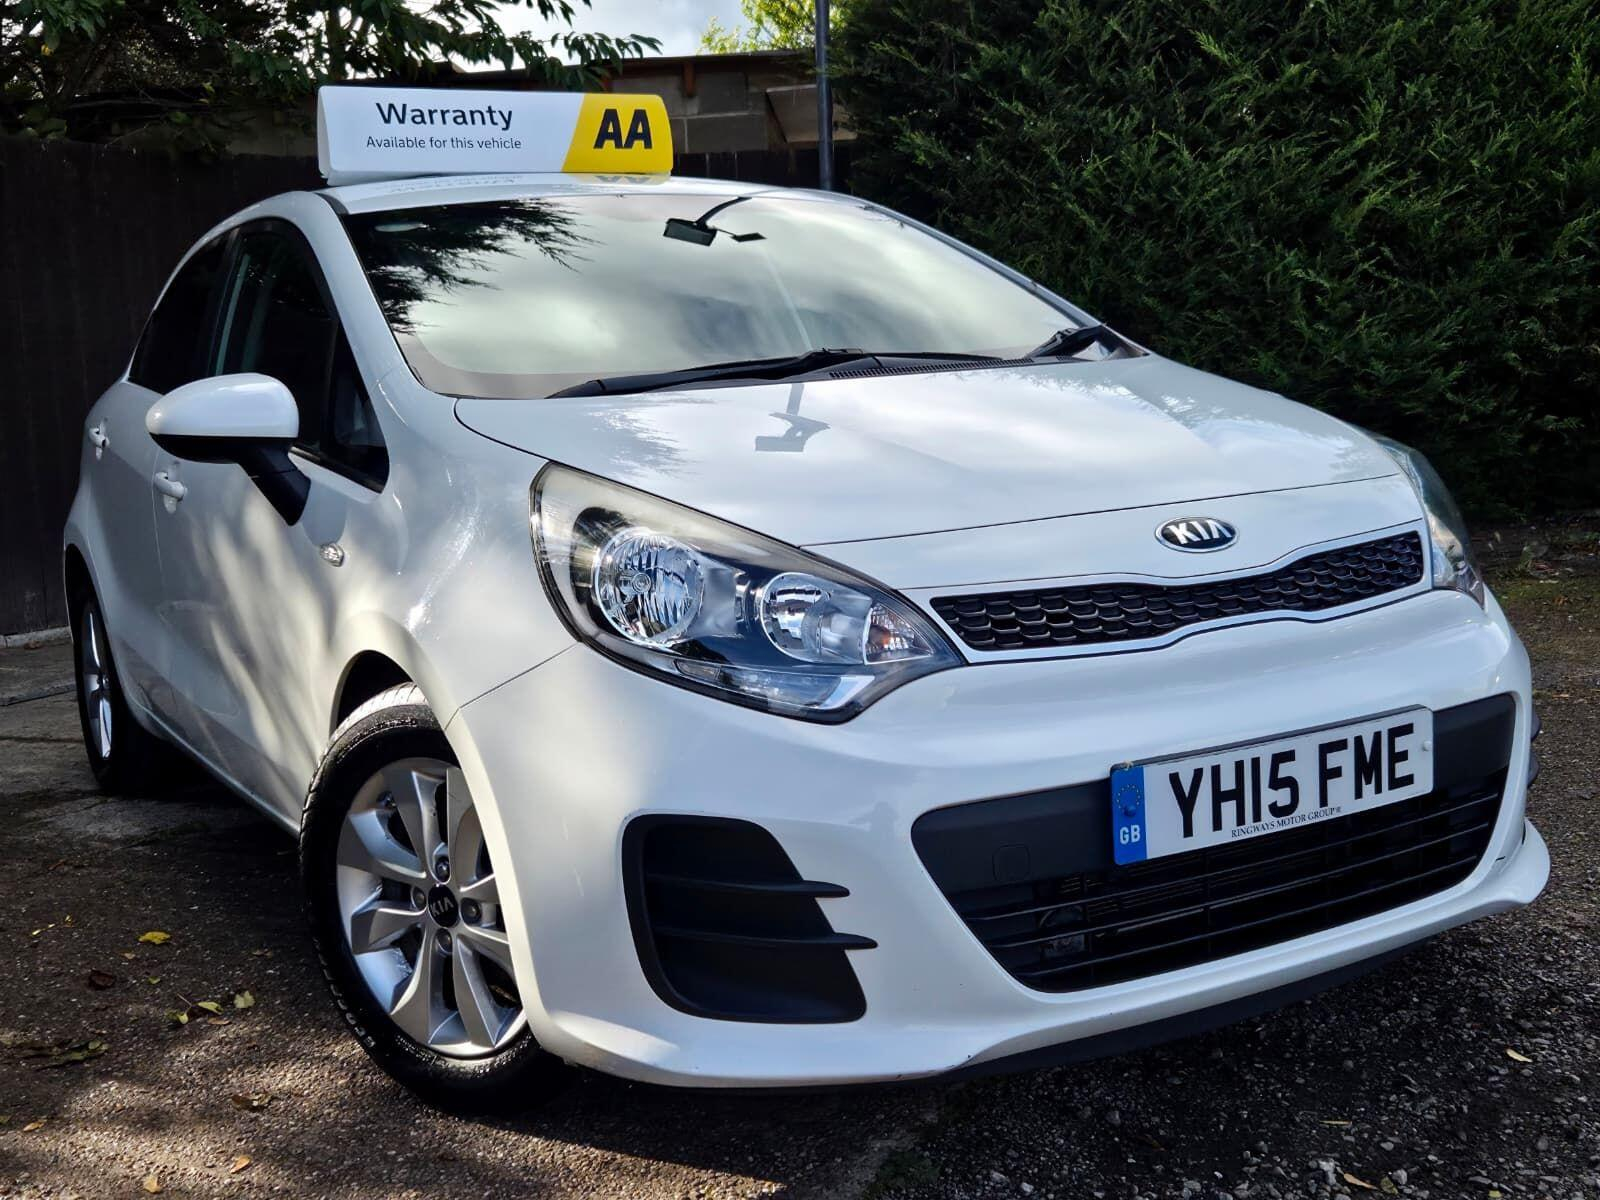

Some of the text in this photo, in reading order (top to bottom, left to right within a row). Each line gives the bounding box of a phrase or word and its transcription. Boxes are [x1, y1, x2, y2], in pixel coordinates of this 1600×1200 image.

[375, 102, 513, 131] Warranty
[593, 108, 653, 150] AA
[366, 136, 522, 149] Available for this vehicle
[1166, 519, 1233, 545] KIA
[1168, 722, 1415, 839] YH15 FME
[1120, 824, 1141, 845] GB
[1231, 820, 1276, 838] RINGWAYS
[1276, 814, 1307, 828] MOTOR
[430, 896, 455, 917] KIA
